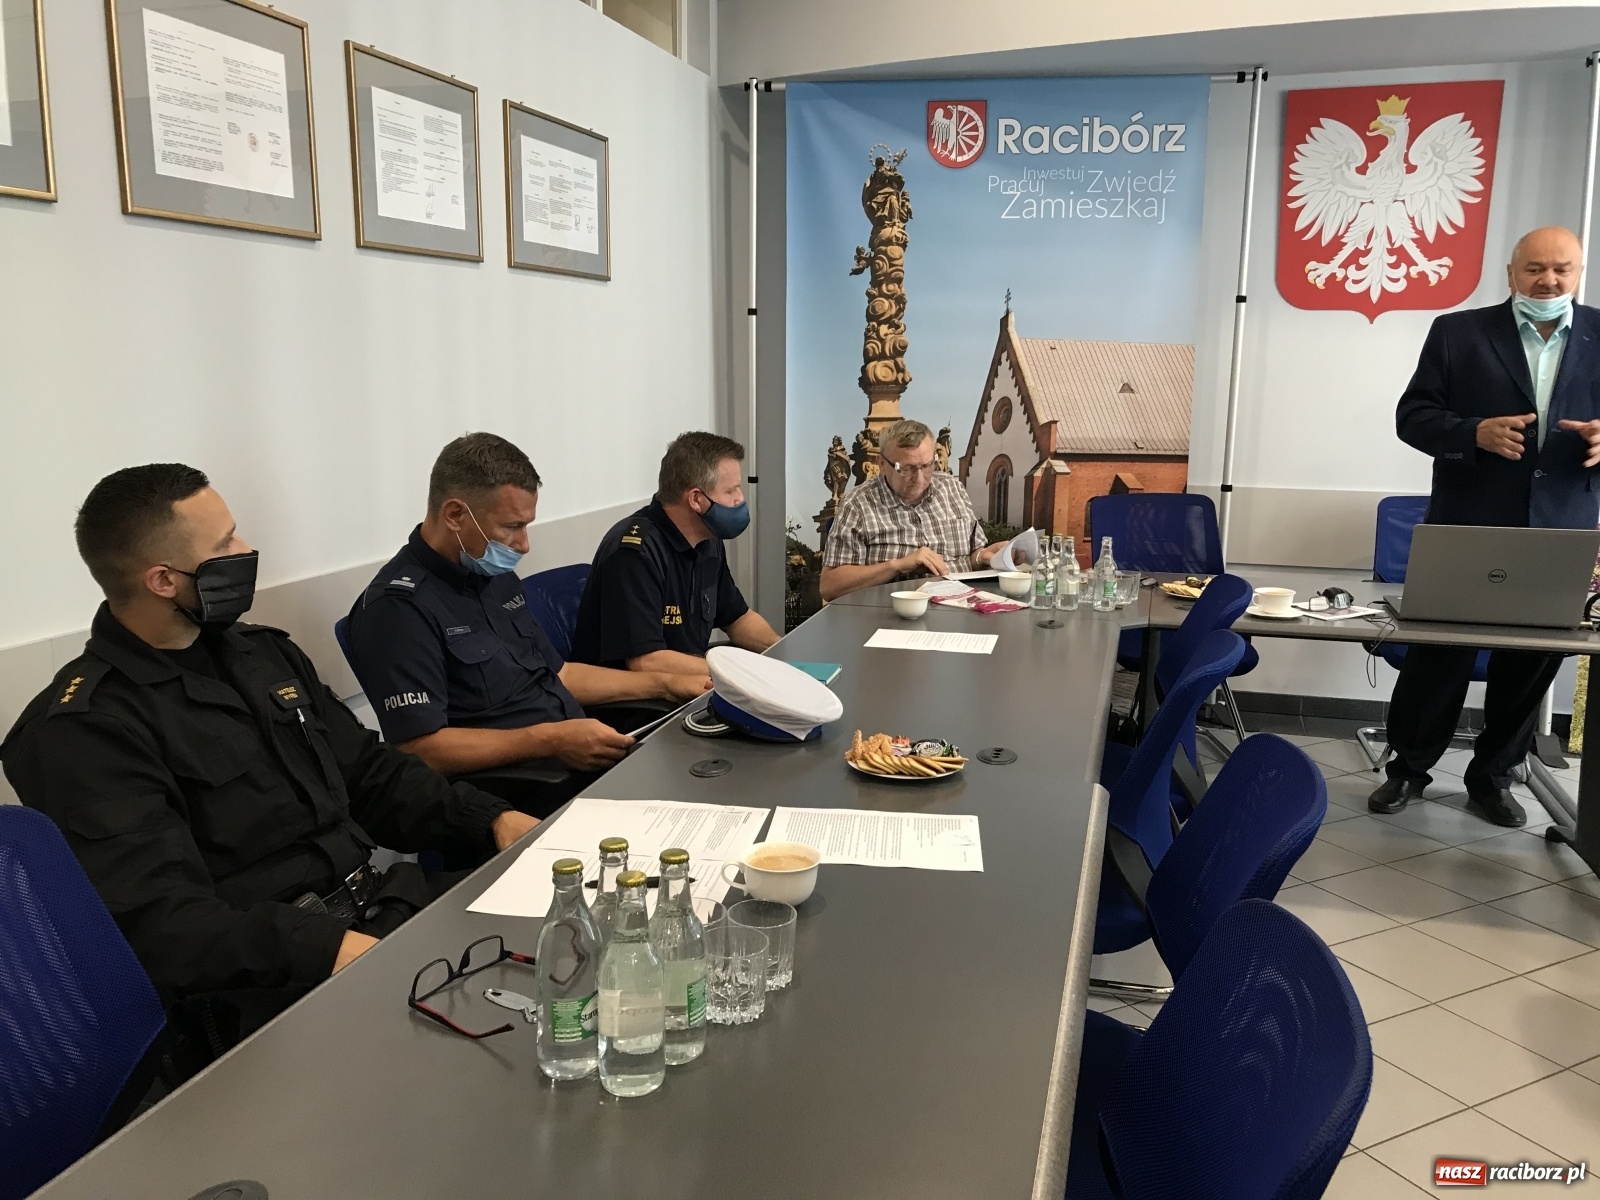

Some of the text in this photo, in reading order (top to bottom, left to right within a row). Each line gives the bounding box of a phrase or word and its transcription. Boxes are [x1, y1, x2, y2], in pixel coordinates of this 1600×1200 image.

[997, 111, 1186, 154] Racibórz
[1023, 166, 1085, 182] Inwestuj
[1086, 169, 1177, 193] Zwiedź
[988, 175, 1045, 196] Pracuj
[1000, 190, 1167, 224] Zamieszkaj
[384, 691, 431, 711] POLICJA
